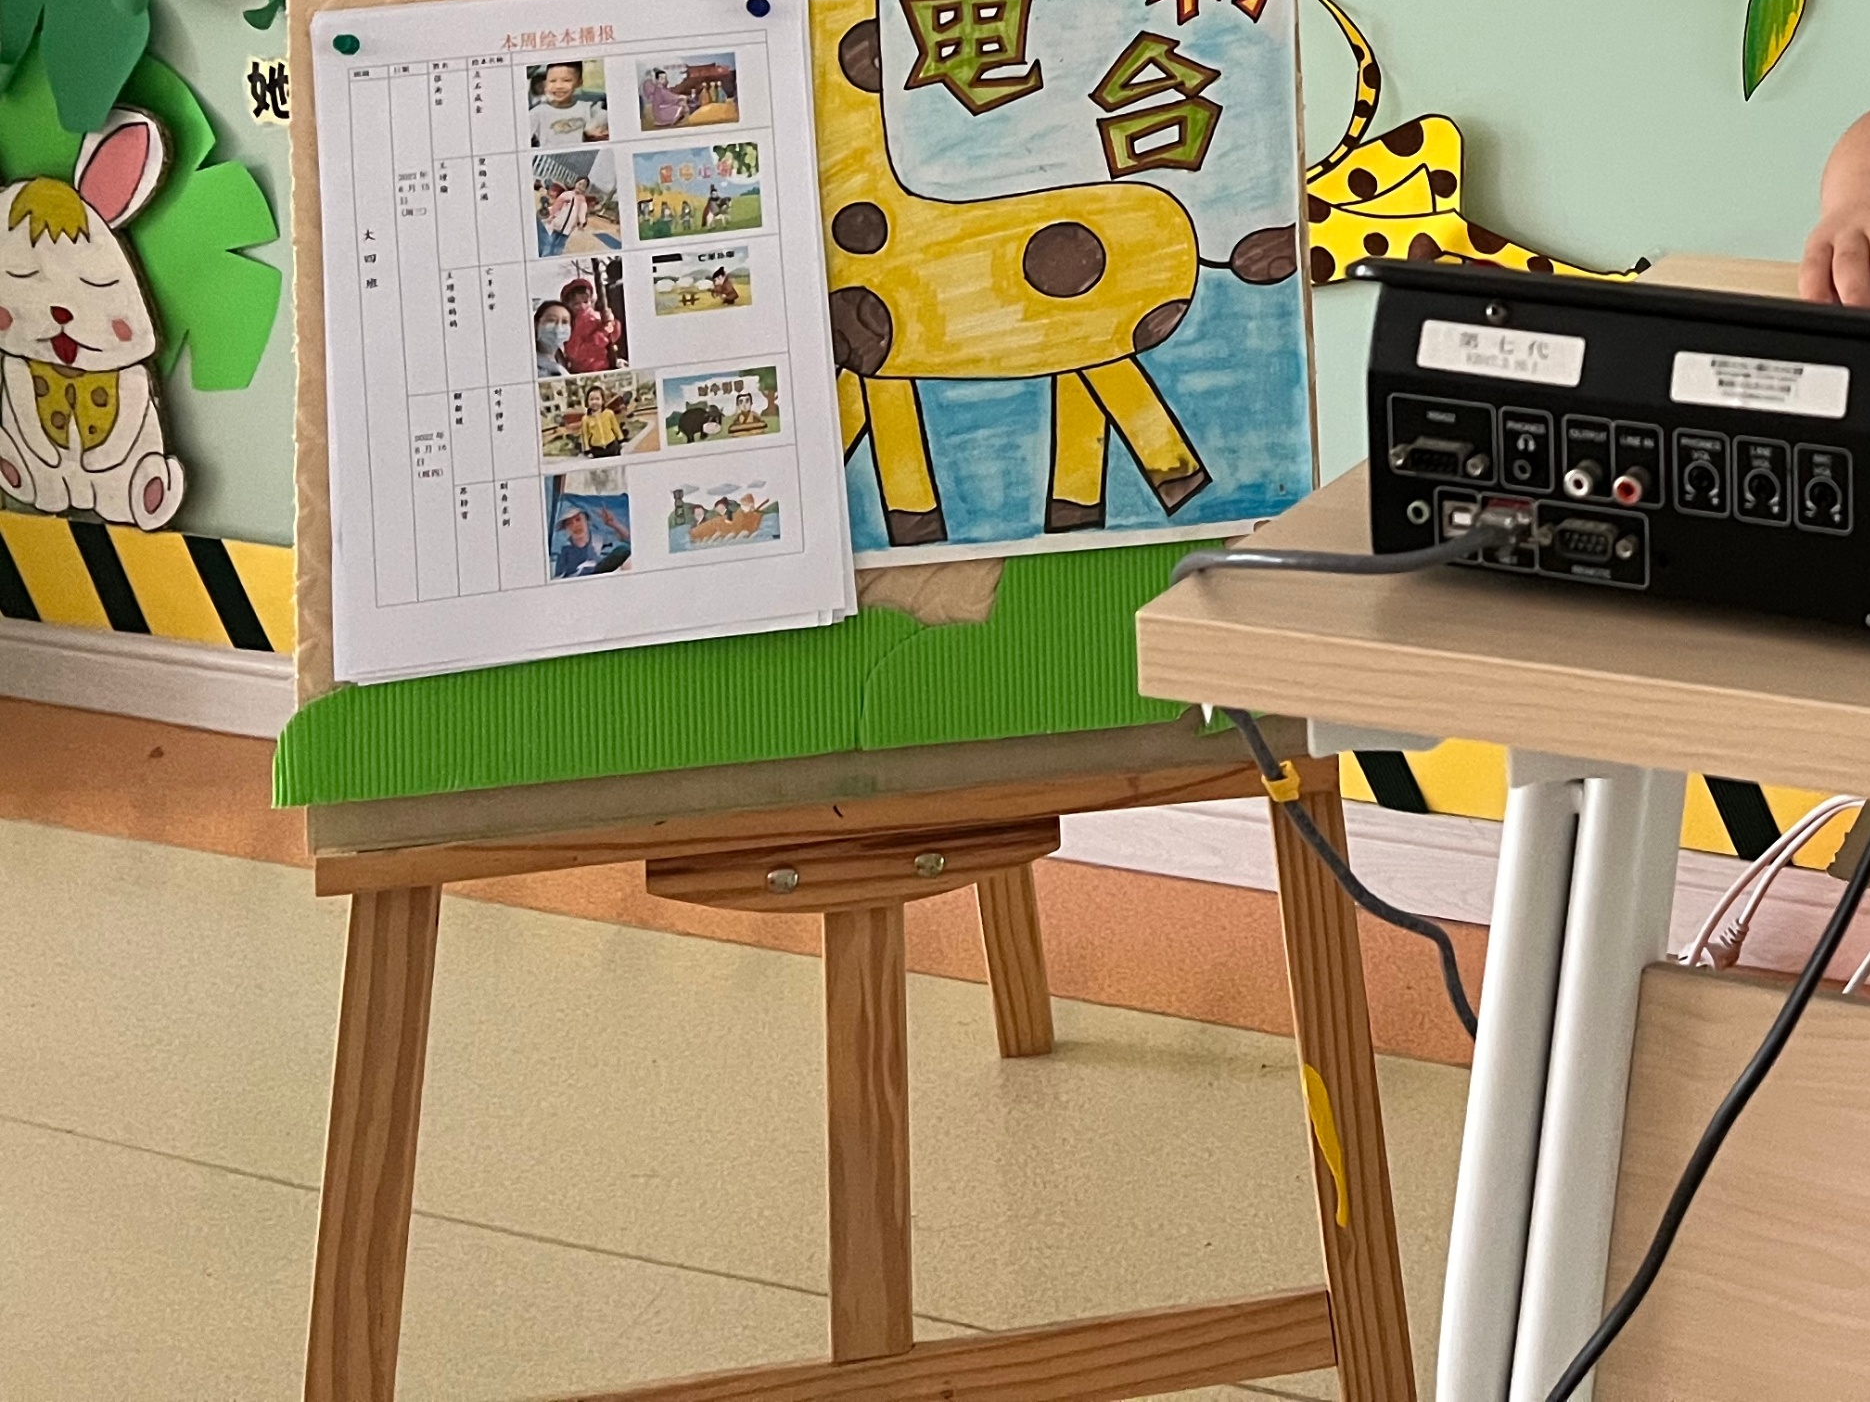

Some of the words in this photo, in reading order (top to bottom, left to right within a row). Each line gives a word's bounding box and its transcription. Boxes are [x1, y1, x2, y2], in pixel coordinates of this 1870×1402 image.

[500, 24, 617, 51] 本周绘本播报
[364, 229, 379, 289] 大四班
